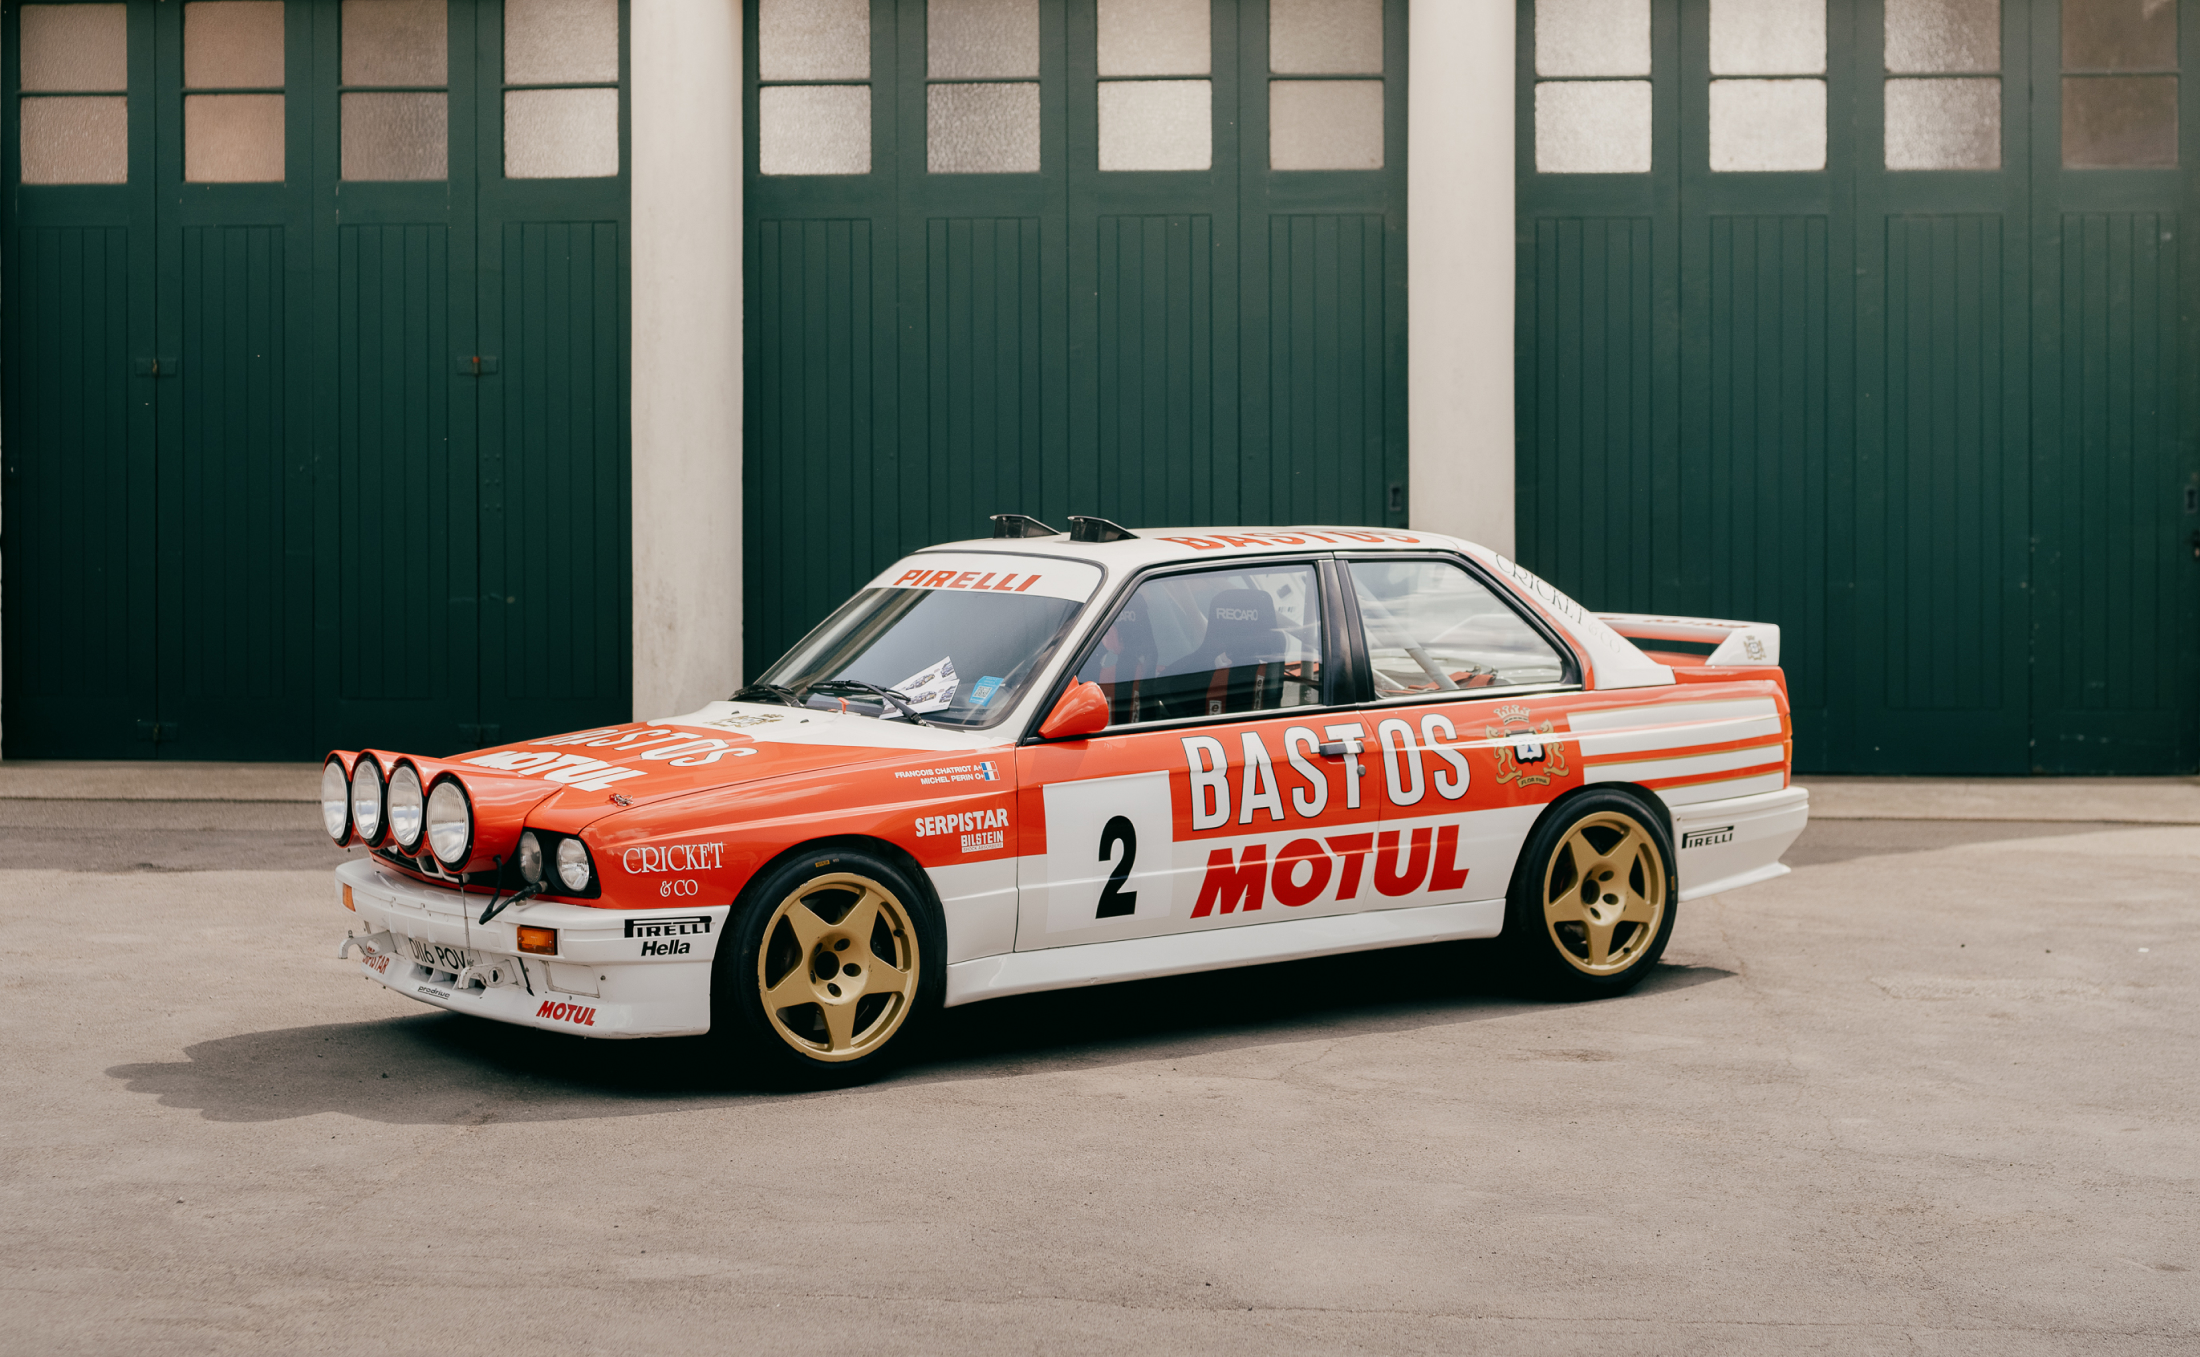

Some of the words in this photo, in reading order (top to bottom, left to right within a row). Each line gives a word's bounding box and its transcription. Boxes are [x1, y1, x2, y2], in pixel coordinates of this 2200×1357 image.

[1153, 530, 1421, 551] BASTOS
[893, 569, 1043, 592] PIRELLI
[1495, 553, 1586, 625] CRICKET
[1216, 607, 1258, 621] RECARO
[461, 750, 649, 792] MOTUL
[920, 776, 950, 785] MICHEL
[951, 773, 973, 783] PERIN
[935, 764, 971, 775] CHATRIOT
[1180, 713, 1471, 831] BASTOS
[914, 808, 1010, 838] SERPISTAR
[960, 830, 1004, 847] BILSTEIN
[1681, 825, 1735, 849] PIRELLI
[622, 841, 724, 875] CRICKET
[1095, 815, 1138, 919] 2
[1190, 824, 1470, 919] MOTUL
[660, 880, 673, 897] &
[673, 879, 699, 896] CO
[624, 915, 713, 938] PIRELLI
[434, 945, 467, 970] POV
[641, 939, 691, 957] Hella
[535, 1000, 597, 1027] MOTUL
